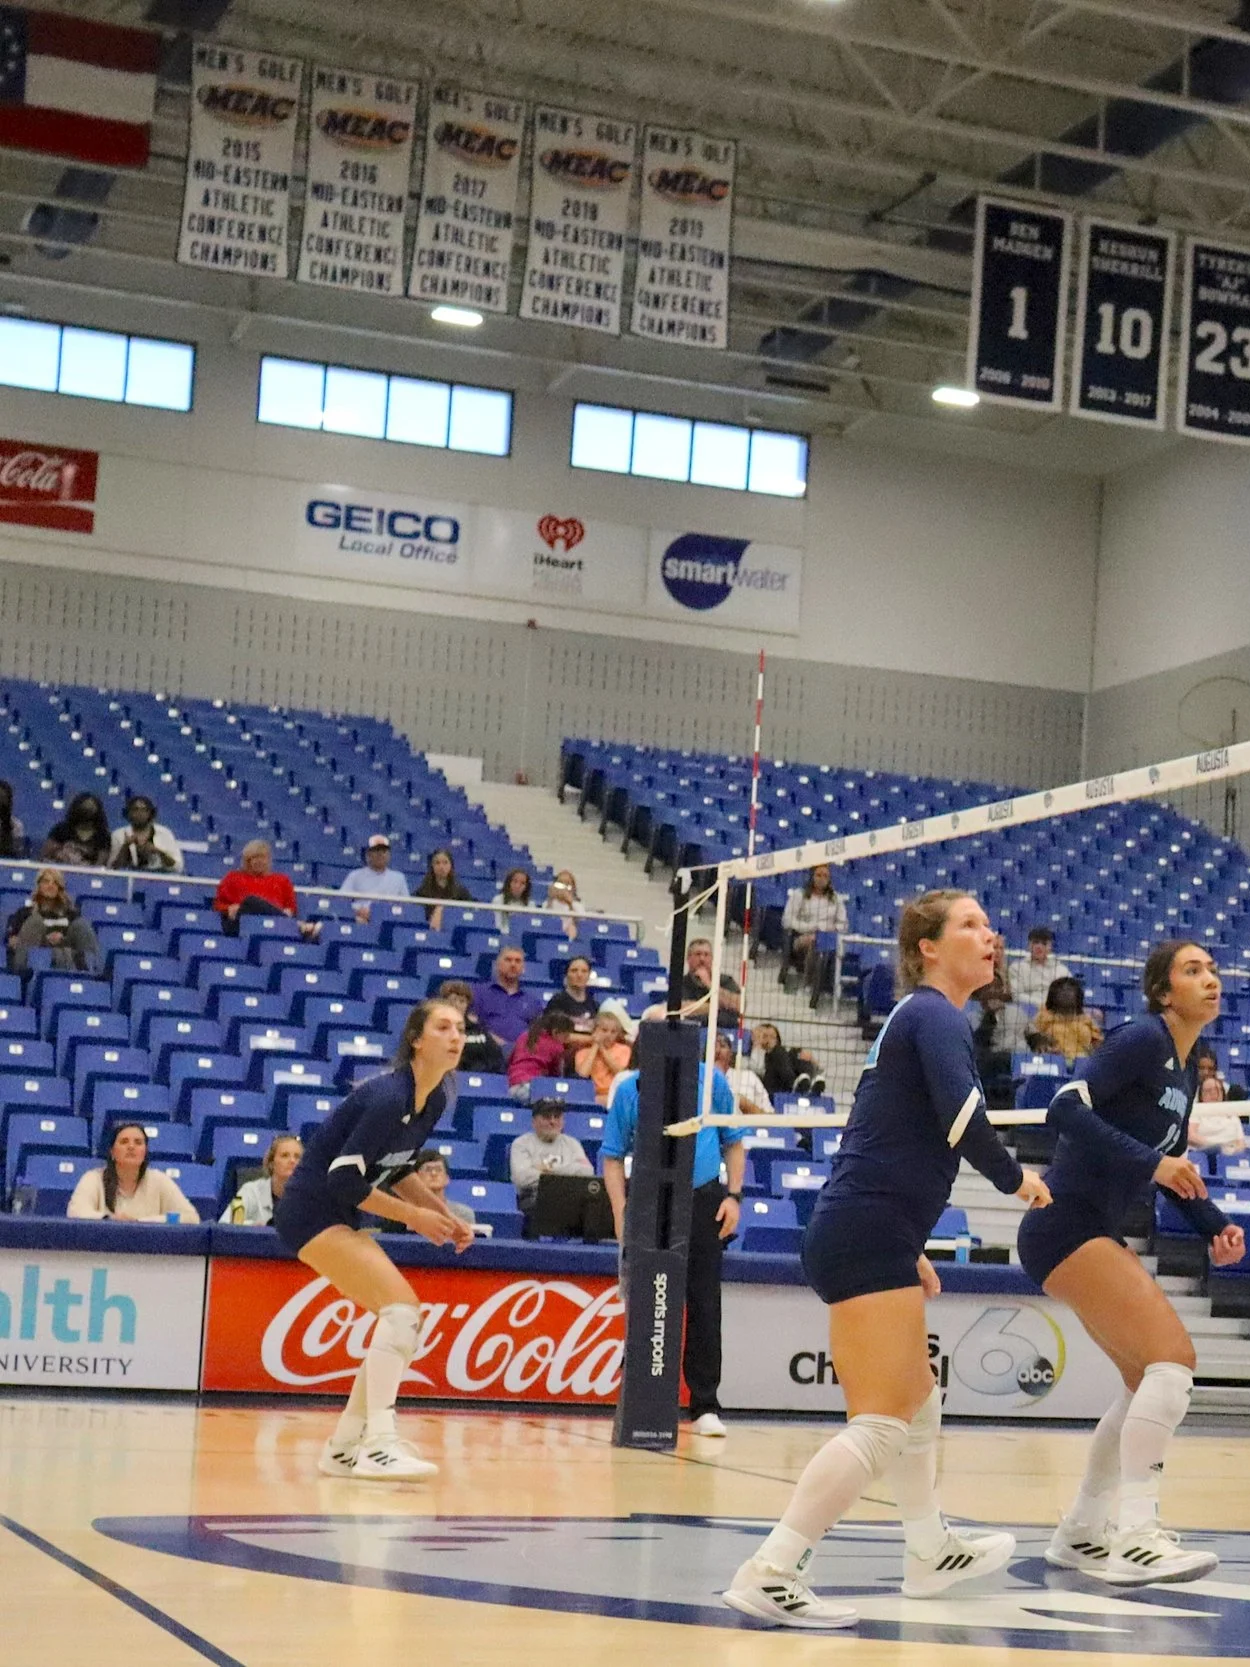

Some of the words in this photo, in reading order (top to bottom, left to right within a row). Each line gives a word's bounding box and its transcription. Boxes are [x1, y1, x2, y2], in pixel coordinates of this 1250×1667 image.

[222, 137, 260, 162] 2015
[202, 188, 275, 217] ATHLETIC
[188, 213, 284, 246] CONFERENCE
[321, 211, 391, 239] ATHLETIC
[433, 223, 499, 253] ATHLETIC
[190, 241, 278, 272] CHAMPIONS
[306, 233, 396, 265] CONFERENCE
[543, 248, 610, 275] ATHLETIC
[310, 262, 392, 292] CHAMPIONS
[417, 250, 507, 281] CONFERENCE
[647, 268, 713, 292] ATHLETIC
[420, 273, 499, 305] CHAMPIONS
[529, 268, 618, 303] CONFERENCE
[531, 295, 611, 328] CHAMPIONS
[638, 288, 722, 320] CONFERENCE
[1008, 286, 1029, 340] 1
[640, 313, 717, 344] CHAMPIONS
[1096, 302, 1153, 359] 10
[306, 500, 460, 544] GEICO
[338, 535, 393, 557] Local
[400, 543, 458, 565] Office
[533, 553, 583, 571] iHeart
[1196, 749, 1230, 774] AUGUSTA
[653, 1273, 668, 1320] sports
[650, 1320, 666, 1377] imports
[952, 1307, 1041, 1396] 6
[1016, 1363, 1056, 1384] abc
